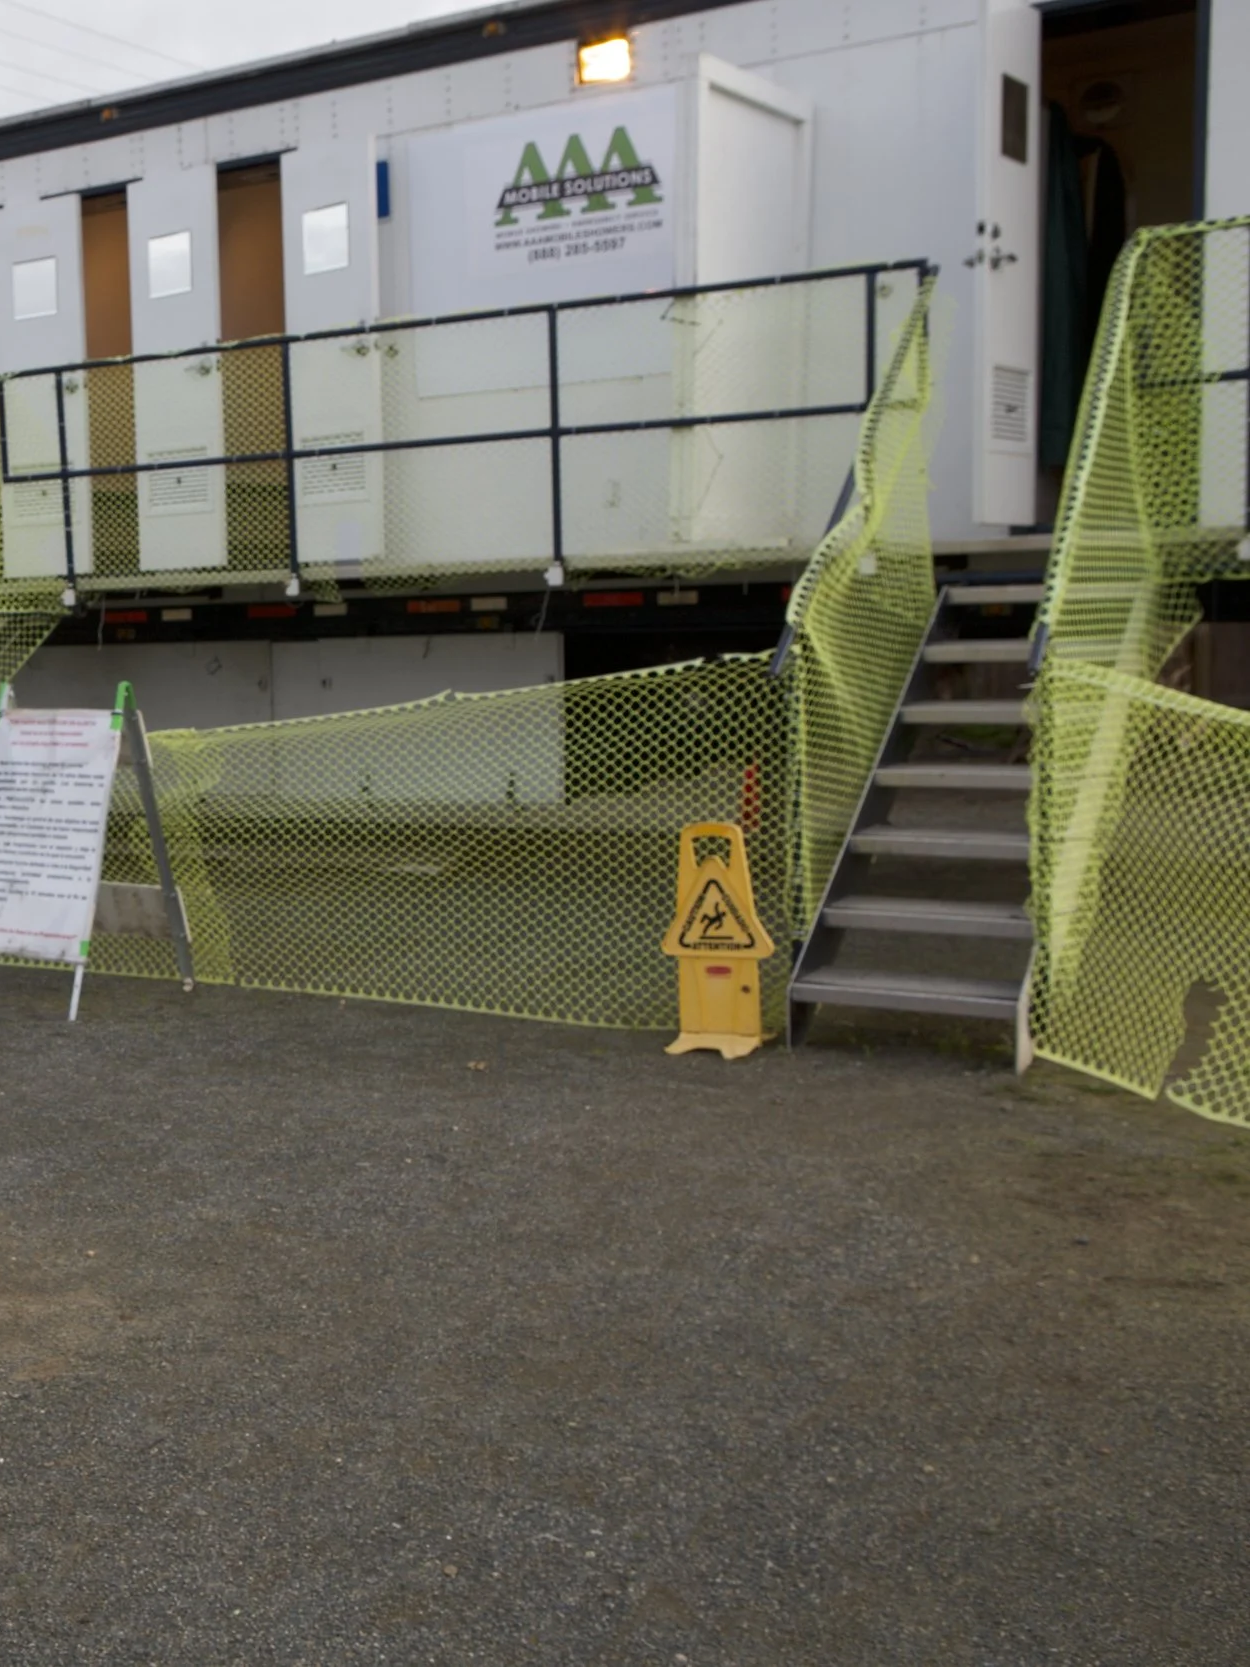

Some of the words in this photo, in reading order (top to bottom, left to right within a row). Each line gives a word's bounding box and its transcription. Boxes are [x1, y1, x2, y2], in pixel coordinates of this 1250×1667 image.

[494, 124, 664, 227] AAA
[504, 181, 560, 204] MOBILE
[563, 167, 653, 197] SOLUTIONS
